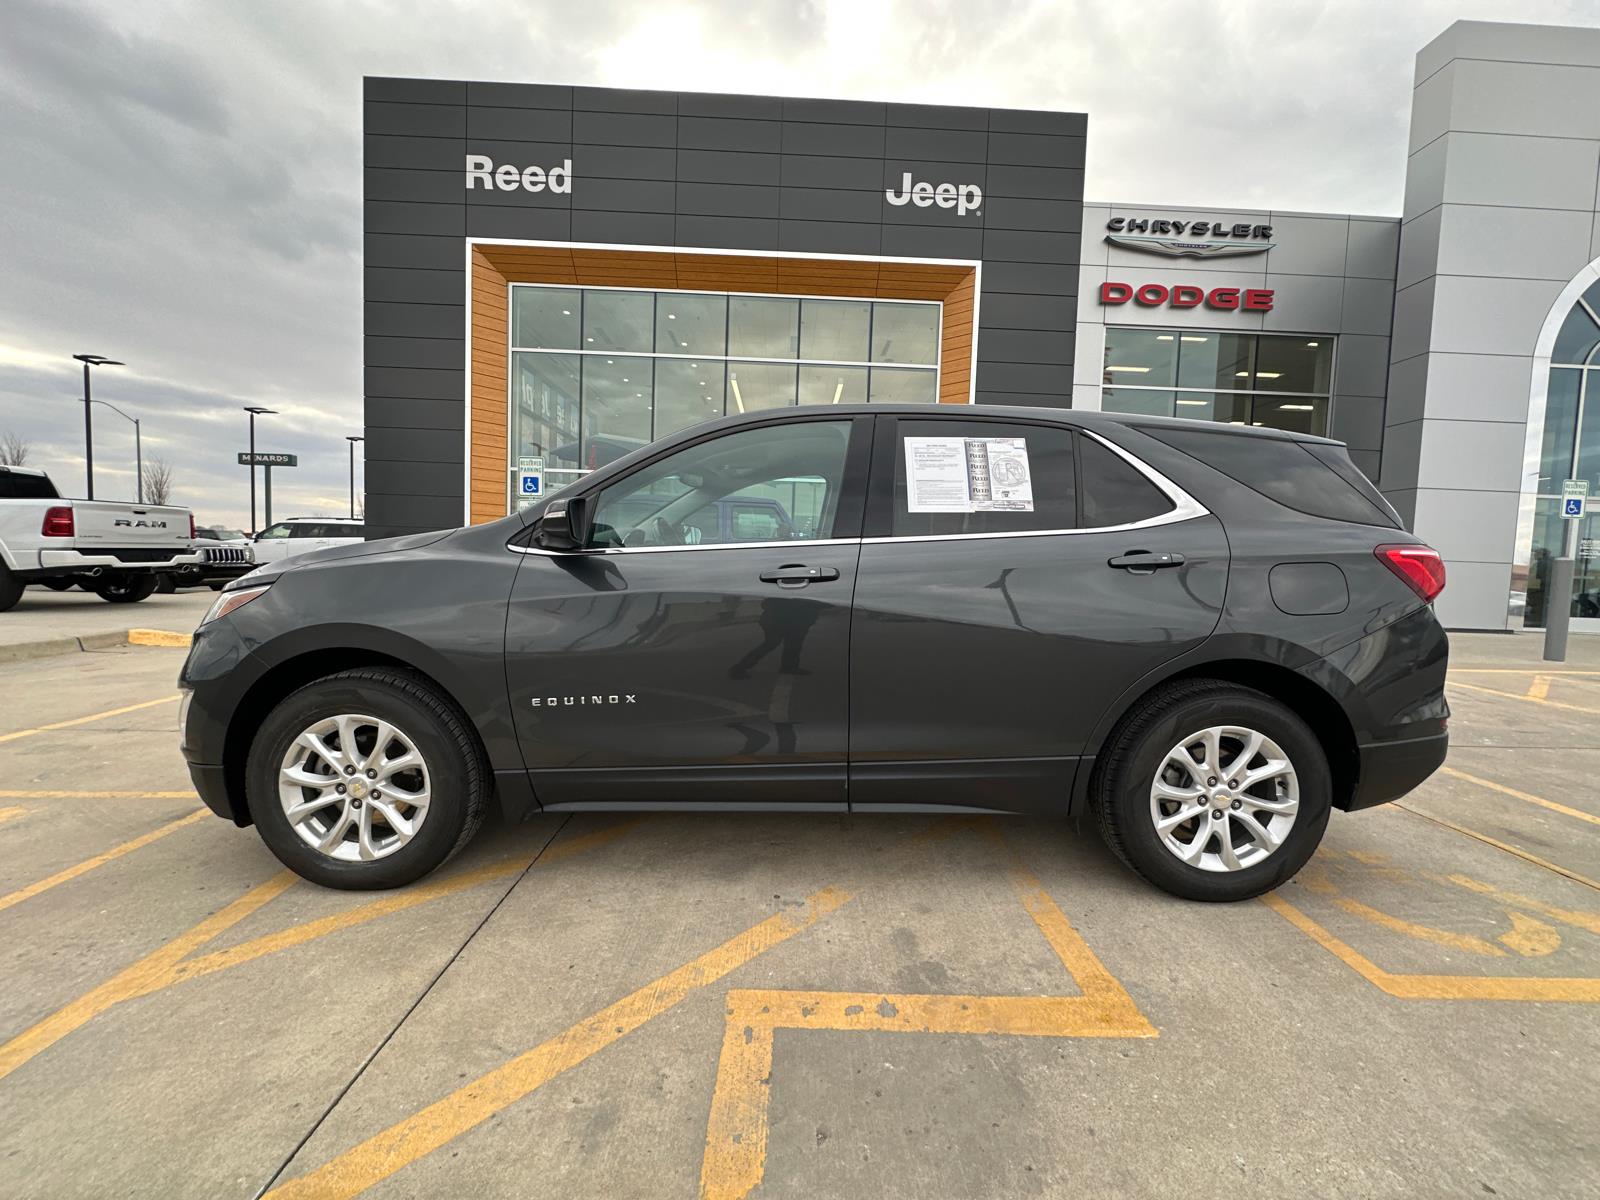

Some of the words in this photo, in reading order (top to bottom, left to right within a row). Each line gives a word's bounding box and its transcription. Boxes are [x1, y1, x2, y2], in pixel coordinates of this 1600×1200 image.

[466, 155, 572, 193] Reed
[886, 172, 982, 216] Jeep
[1107, 217, 1273, 238] CHRYSLER
[1100, 282, 1275, 311] DODGE
[114, 519, 167, 528] RAM
[531, 695, 636, 707] EQUINOX
